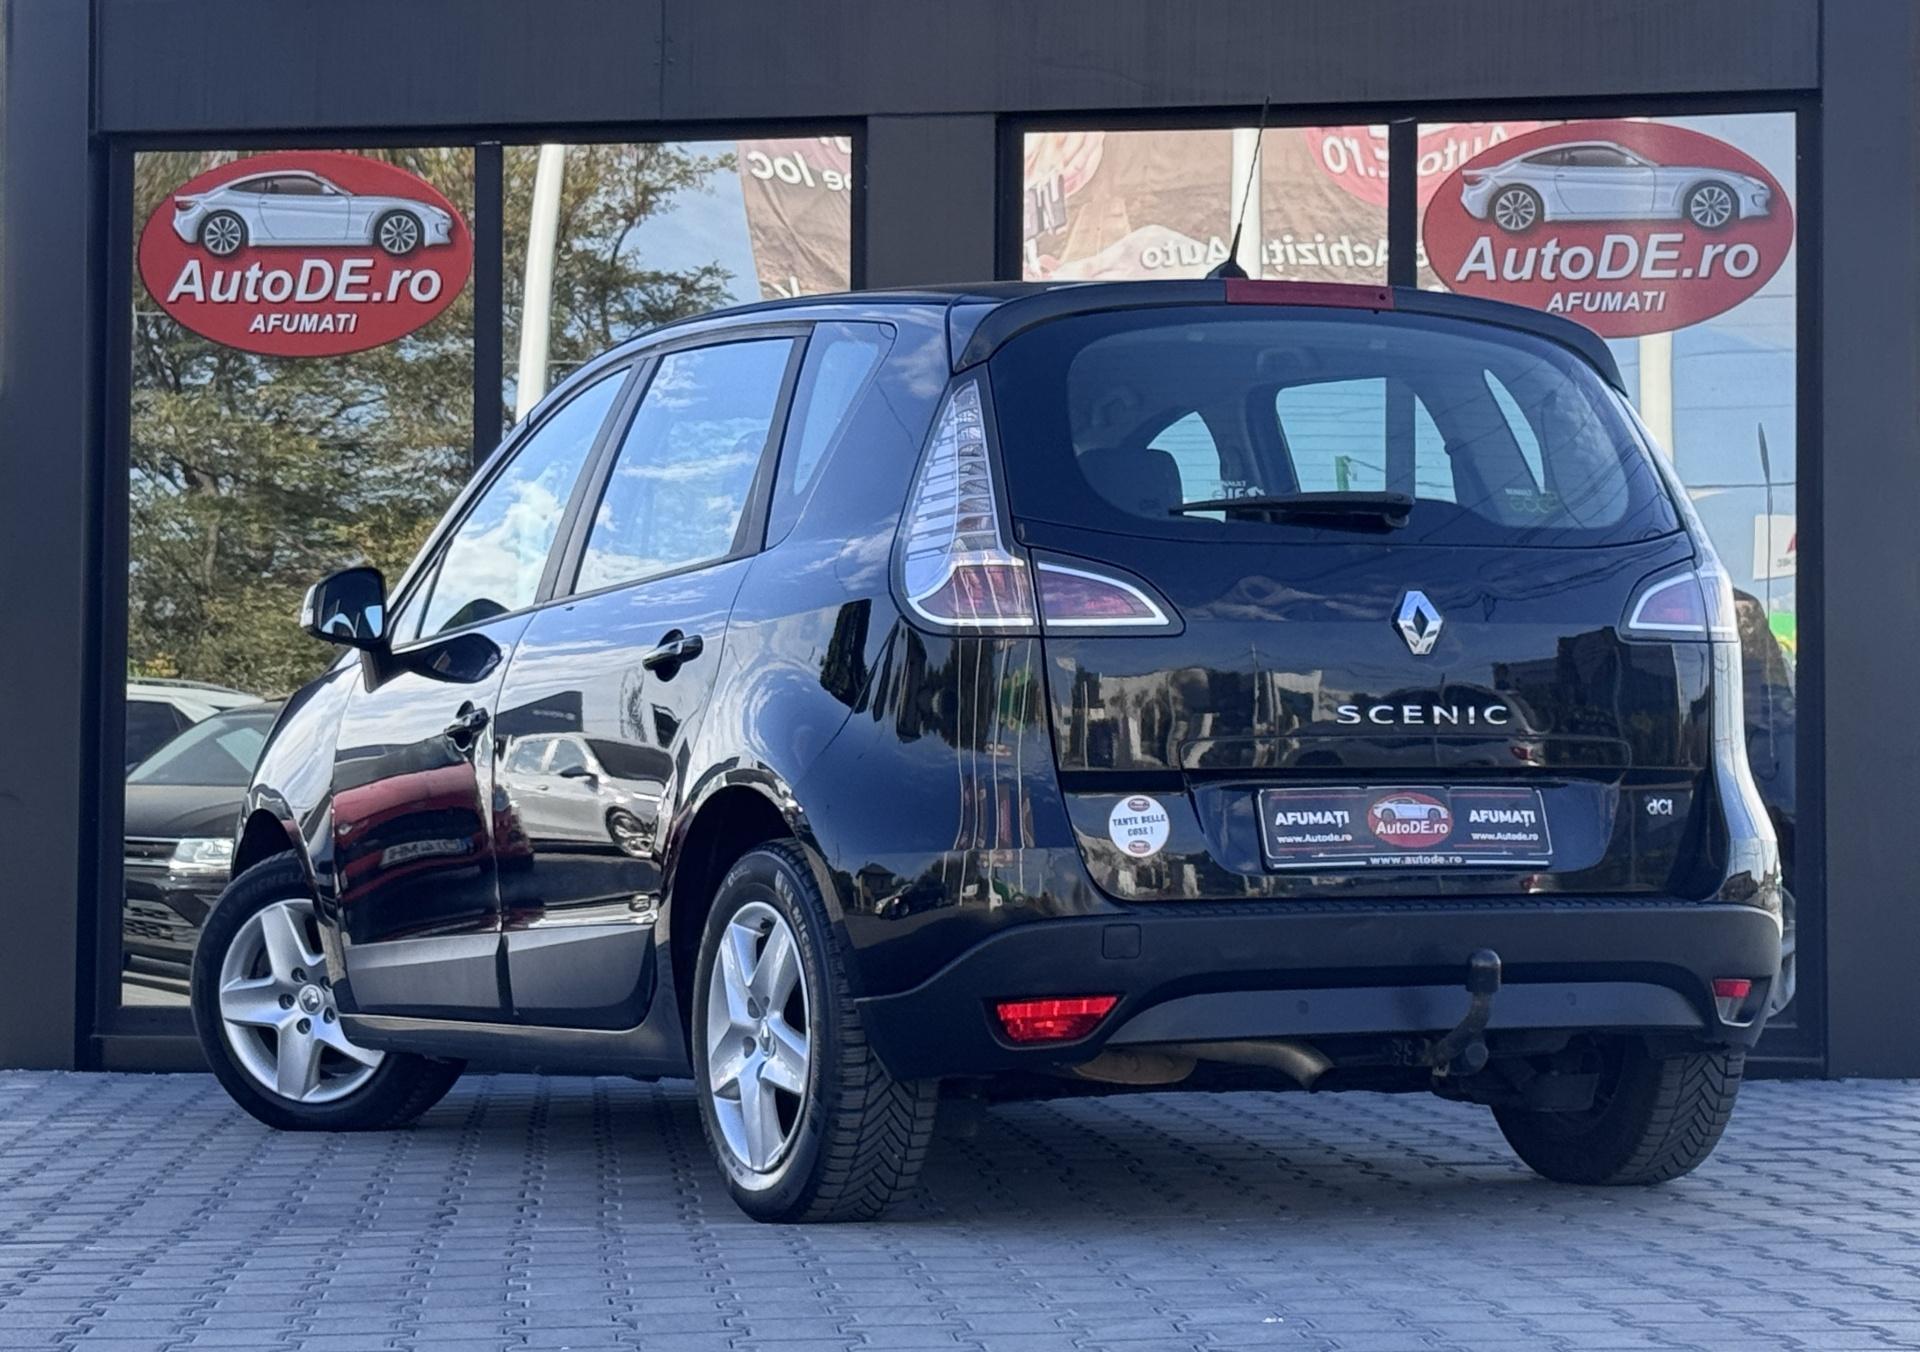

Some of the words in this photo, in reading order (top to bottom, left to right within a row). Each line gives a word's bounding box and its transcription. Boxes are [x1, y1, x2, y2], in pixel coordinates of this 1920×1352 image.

[1455, 233, 1760, 281] AutoDE.ro
[167, 258, 442, 302] AutoDE.ro
[1546, 291, 1666, 312] AFUMATI
[250, 313, 357, 334] AFUMATI
[1336, 705, 1508, 725] SCENIC
[1376, 820, 1449, 835] AutoDE.ro
[1370, 854, 1463, 865] www.autode.ro
